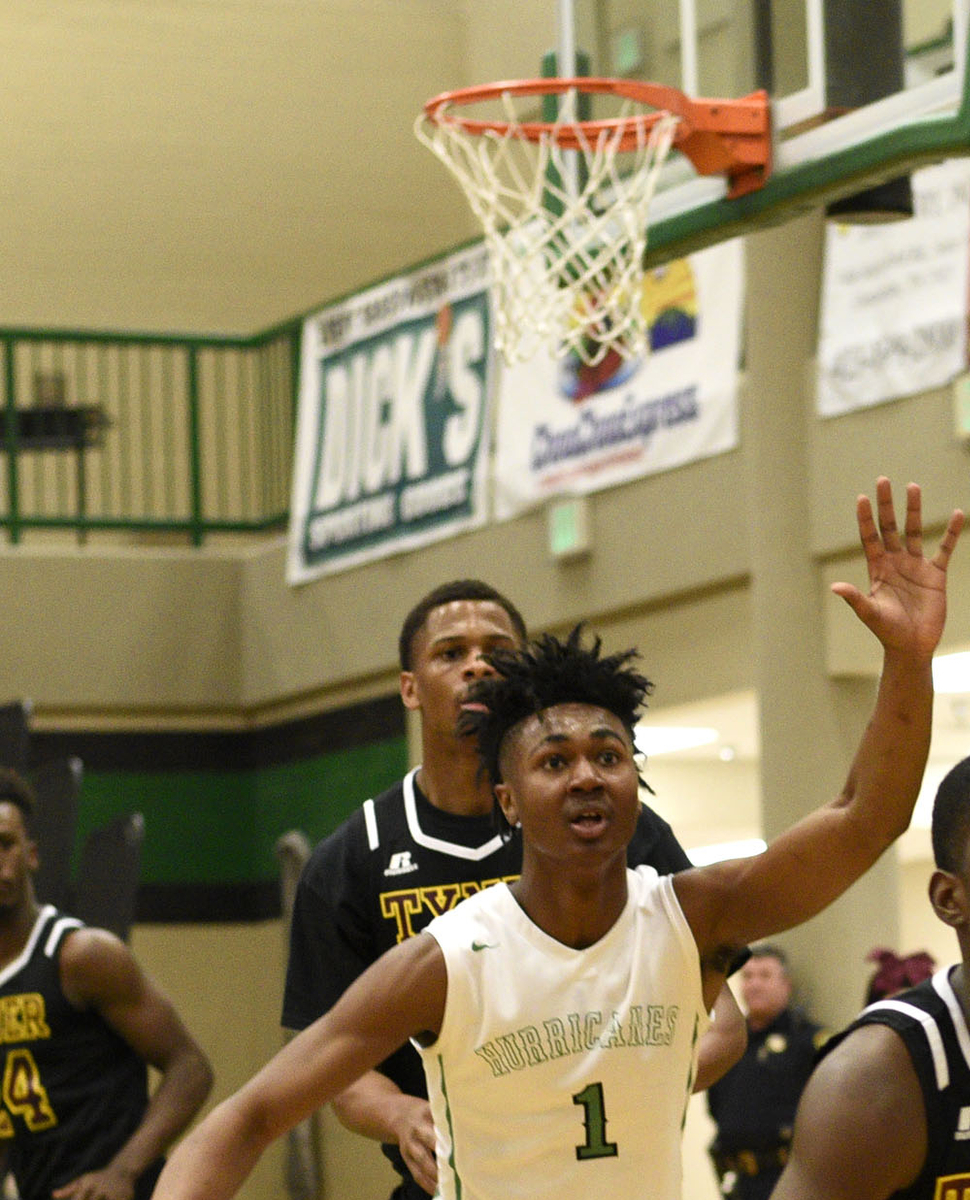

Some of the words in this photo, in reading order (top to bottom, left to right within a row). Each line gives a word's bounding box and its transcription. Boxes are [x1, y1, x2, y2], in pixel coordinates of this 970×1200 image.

[315, 303, 484, 509] DICK'S
[474, 1004, 680, 1078] HURRICANES
[572, 1081, 619, 1161] 1
